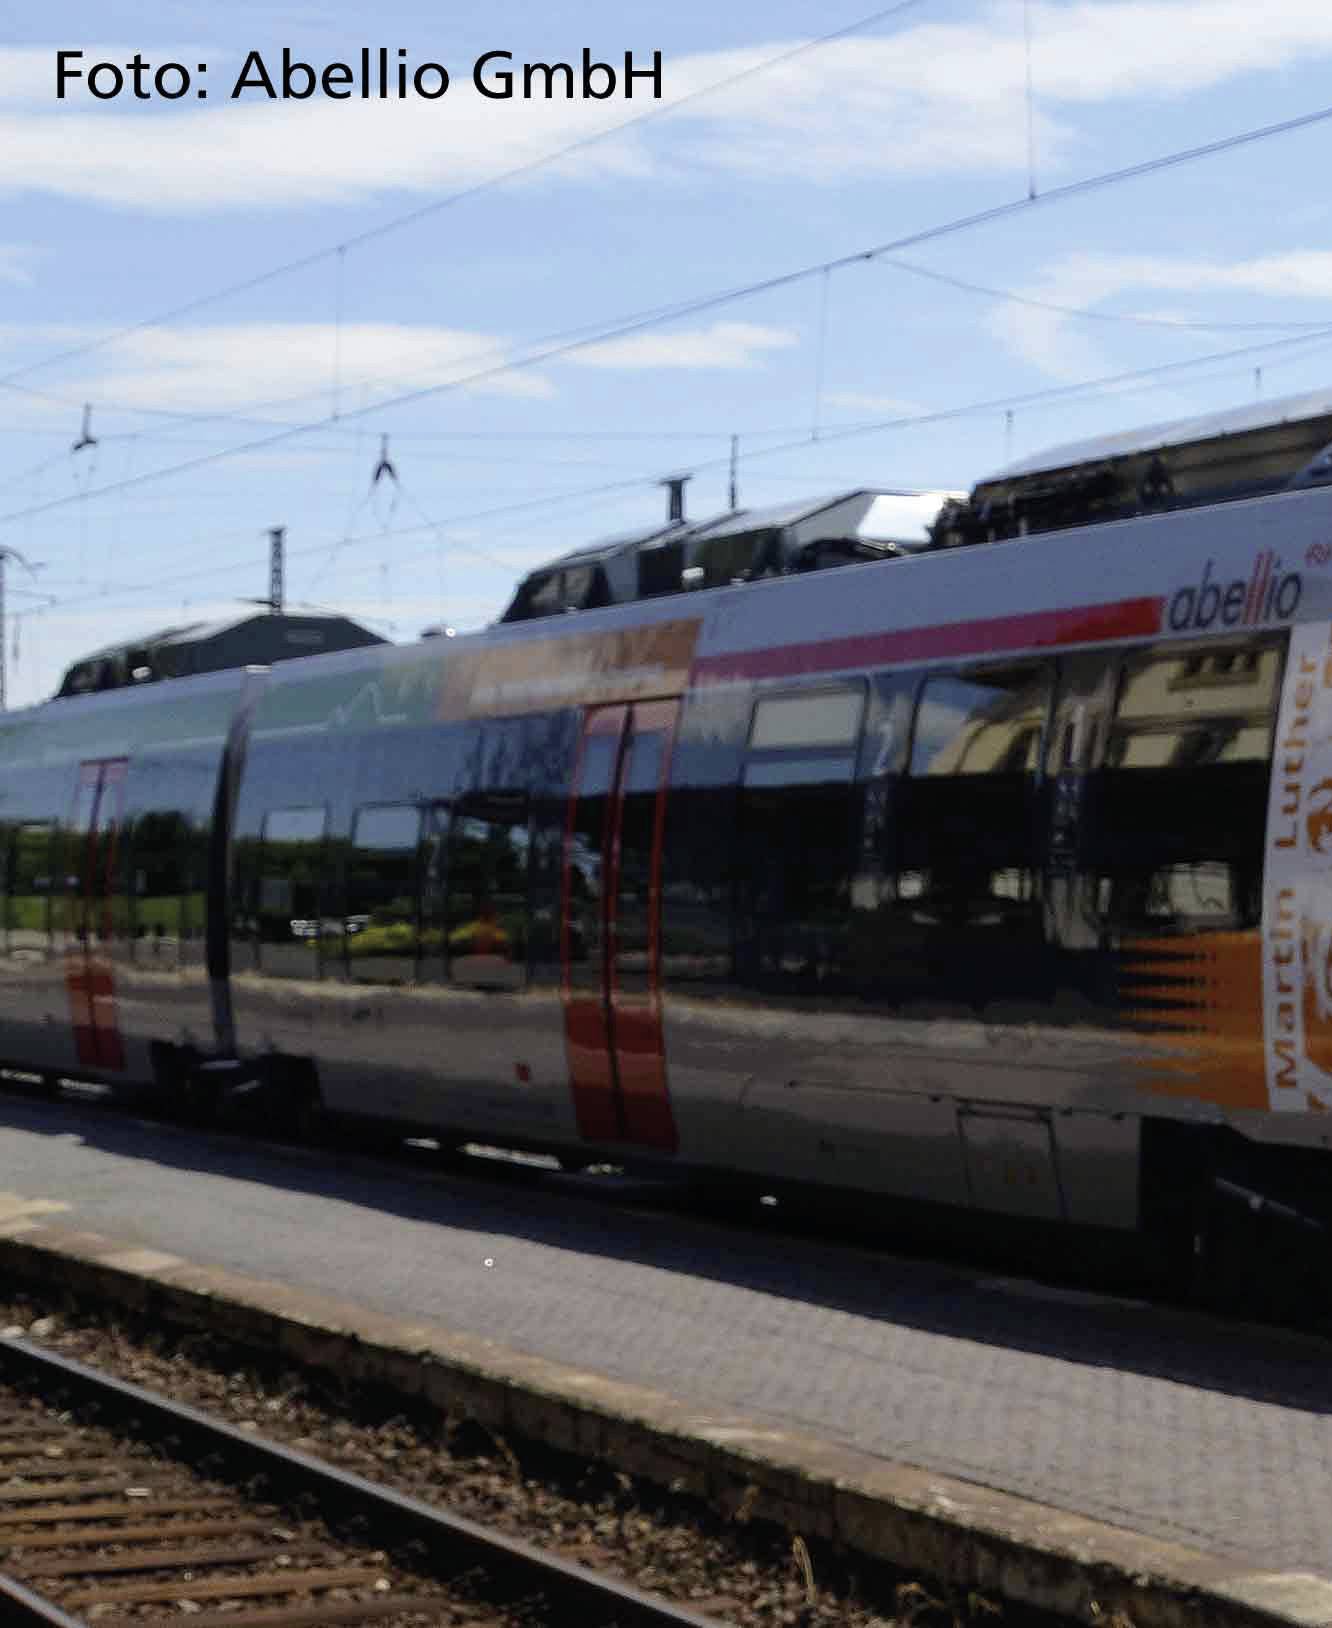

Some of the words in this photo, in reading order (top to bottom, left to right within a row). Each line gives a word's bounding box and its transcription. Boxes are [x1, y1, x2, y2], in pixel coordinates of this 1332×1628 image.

[1168, 548, 1304, 632] abellio
[1275, 654, 1319, 849] Luther
[1269, 888, 1299, 1090] Martin
